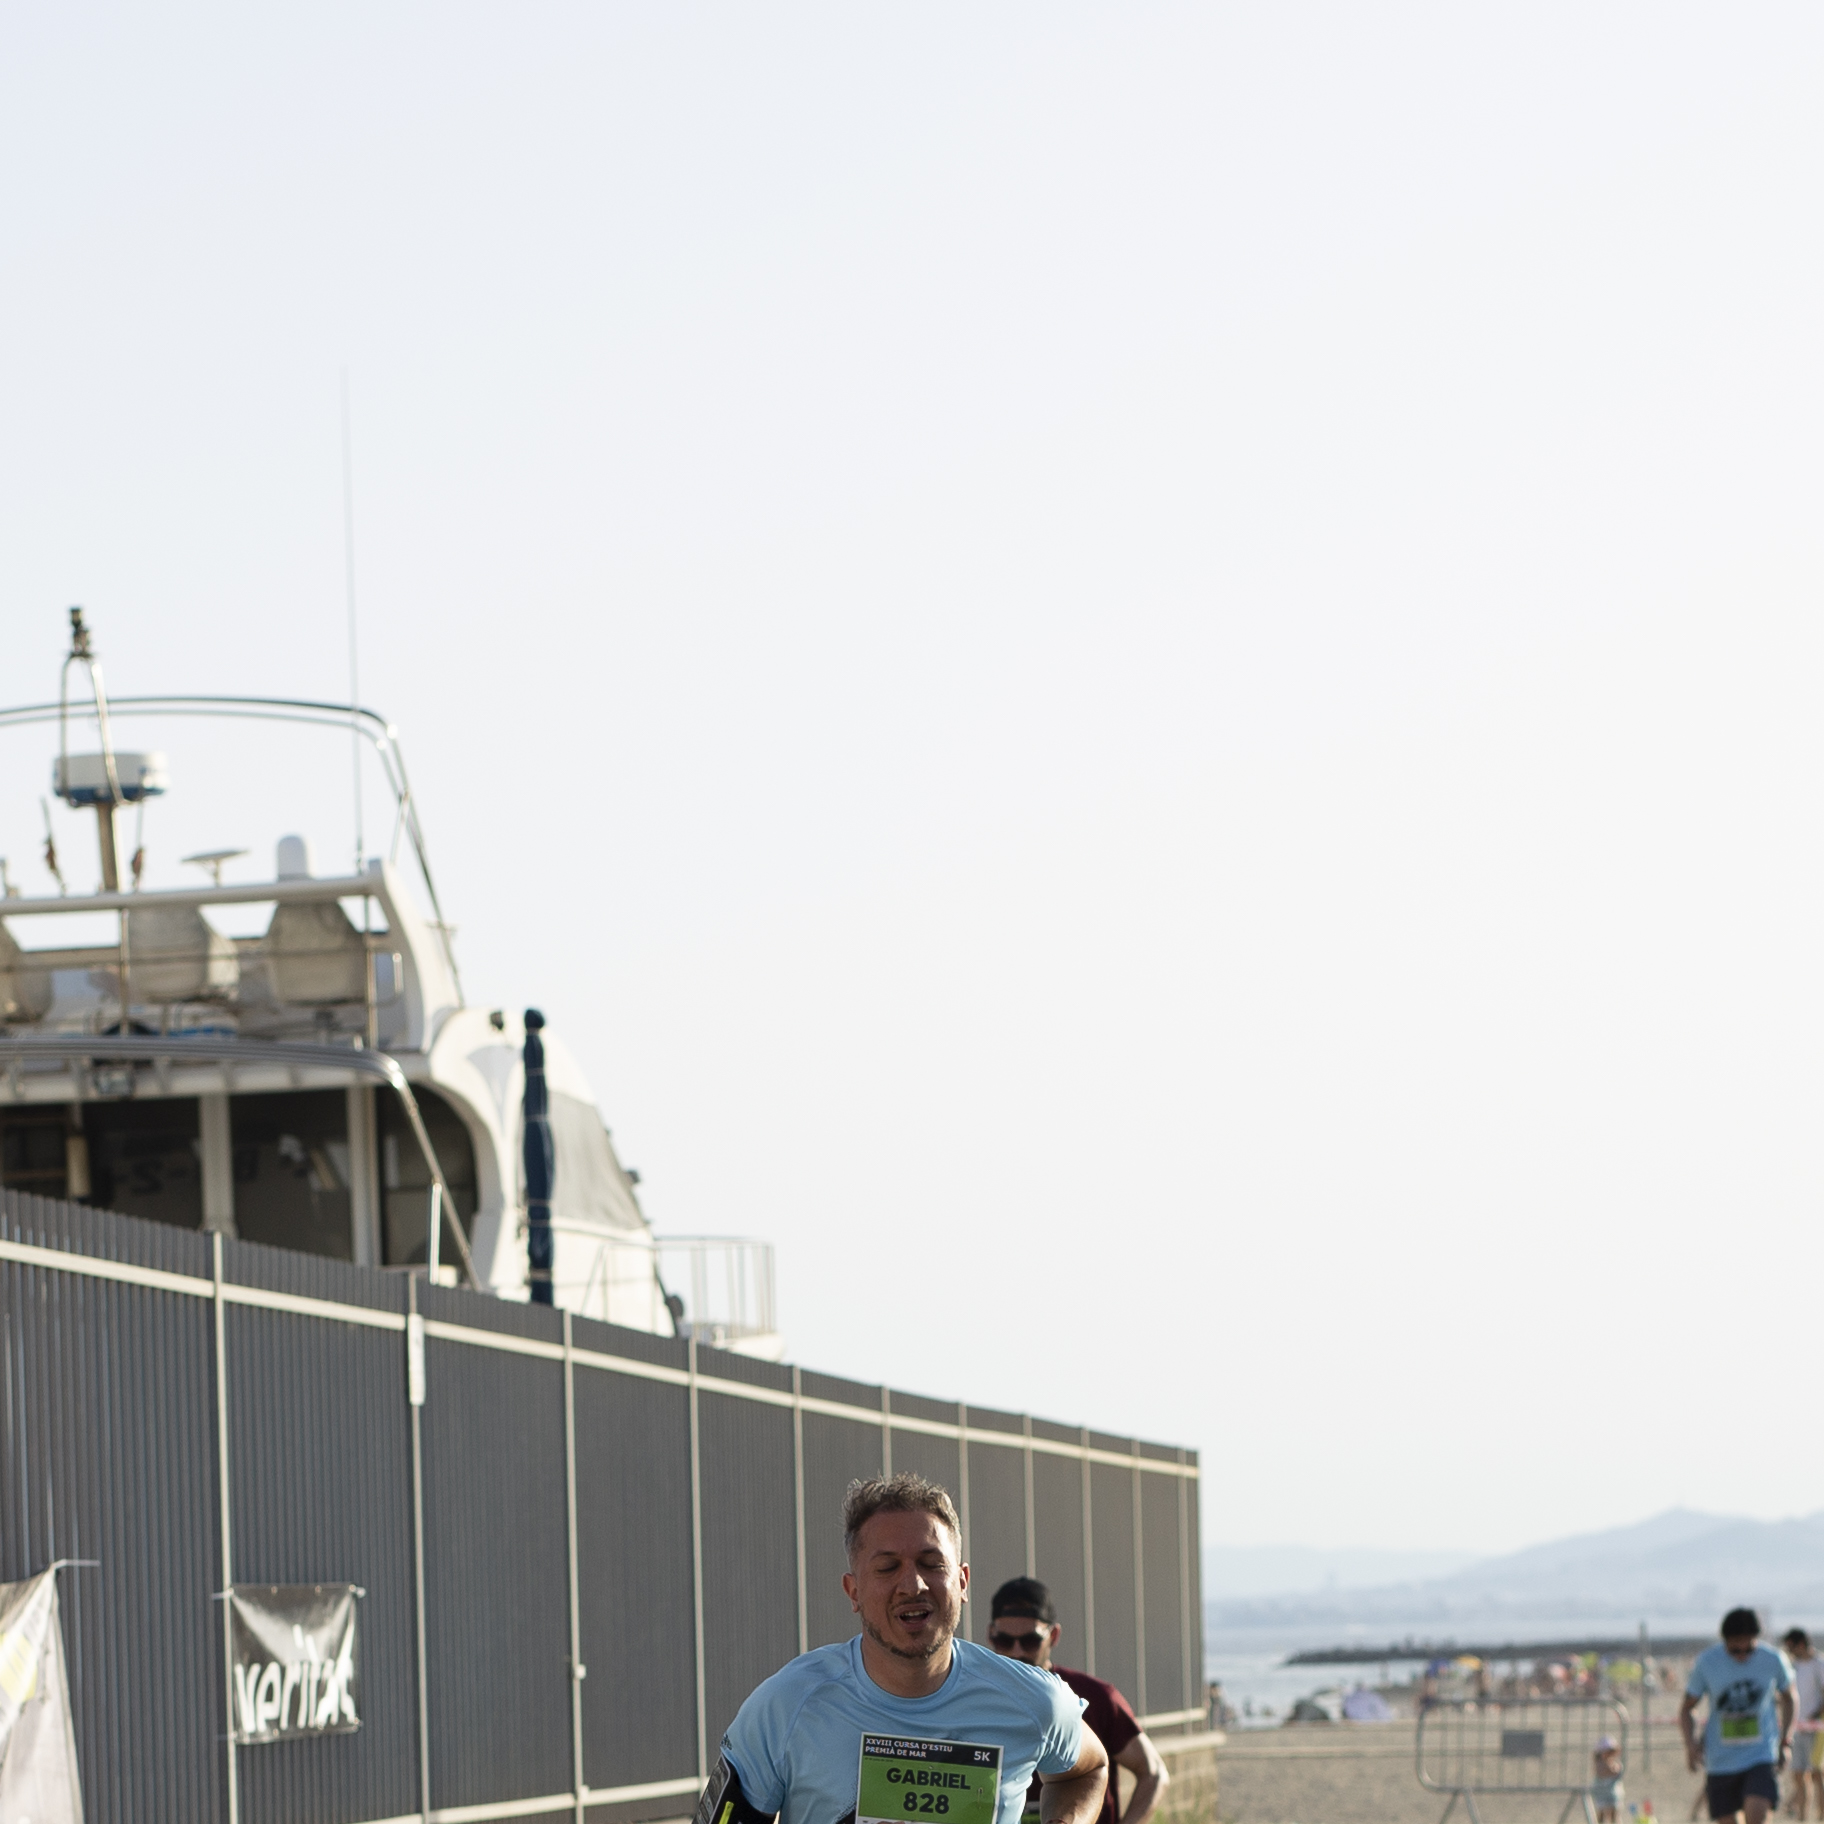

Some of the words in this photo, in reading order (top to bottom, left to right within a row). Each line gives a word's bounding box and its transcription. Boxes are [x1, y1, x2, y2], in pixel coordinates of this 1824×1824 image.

[865, 1746, 895, 1755] PREMIÀ
[909, 1750, 927, 1758] MAR
[894, 1740, 920, 1750] CURSA
[921, 1743, 953, 1753] D'ESTIU
[973, 1751, 991, 1761] 5K
[886, 1767, 971, 1790] GABRIEL
[903, 1792, 950, 1814] 828
